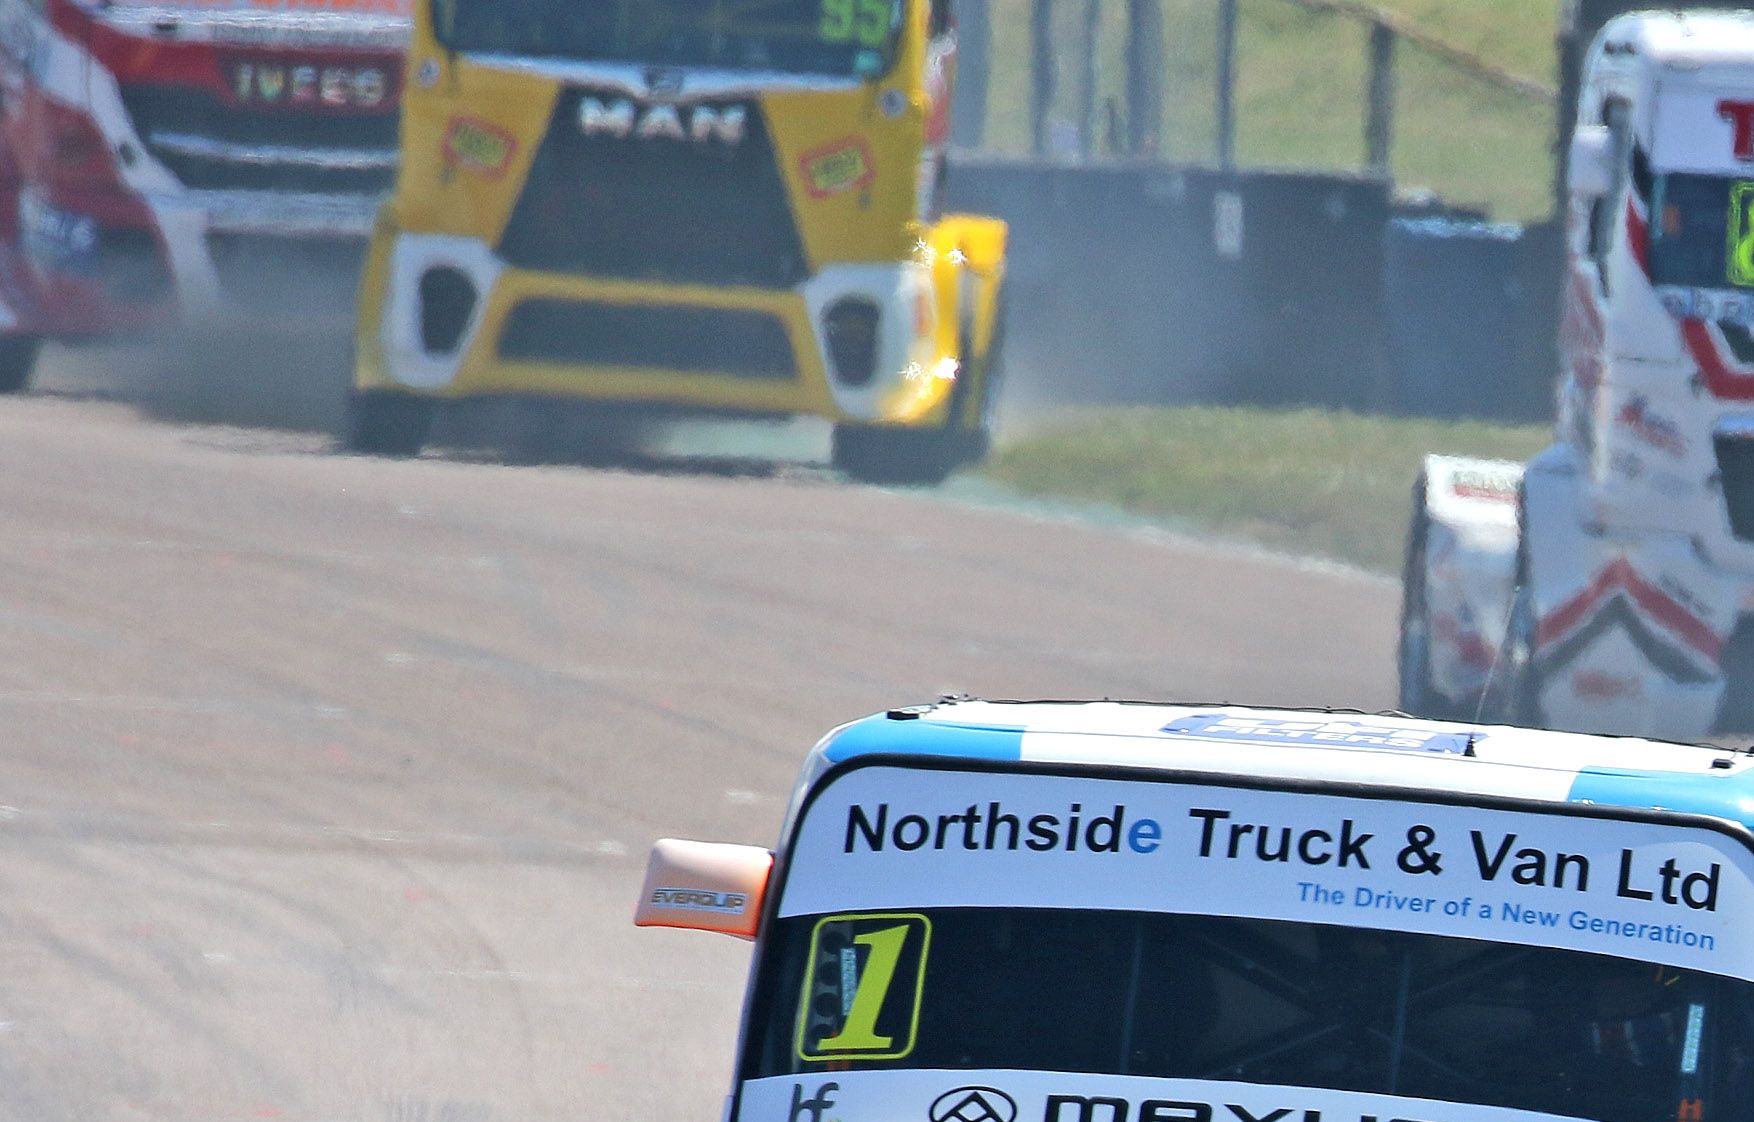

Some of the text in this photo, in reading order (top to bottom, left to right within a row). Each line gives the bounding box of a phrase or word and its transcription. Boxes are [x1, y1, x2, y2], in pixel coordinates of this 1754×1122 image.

[579, 96, 746, 143] MAN
[844, 802, 1721, 912] Northside Truck & Van Ltd
[1298, 882, 1715, 951] The Driver of a New Generation
[817, 924, 910, 1050] 1
